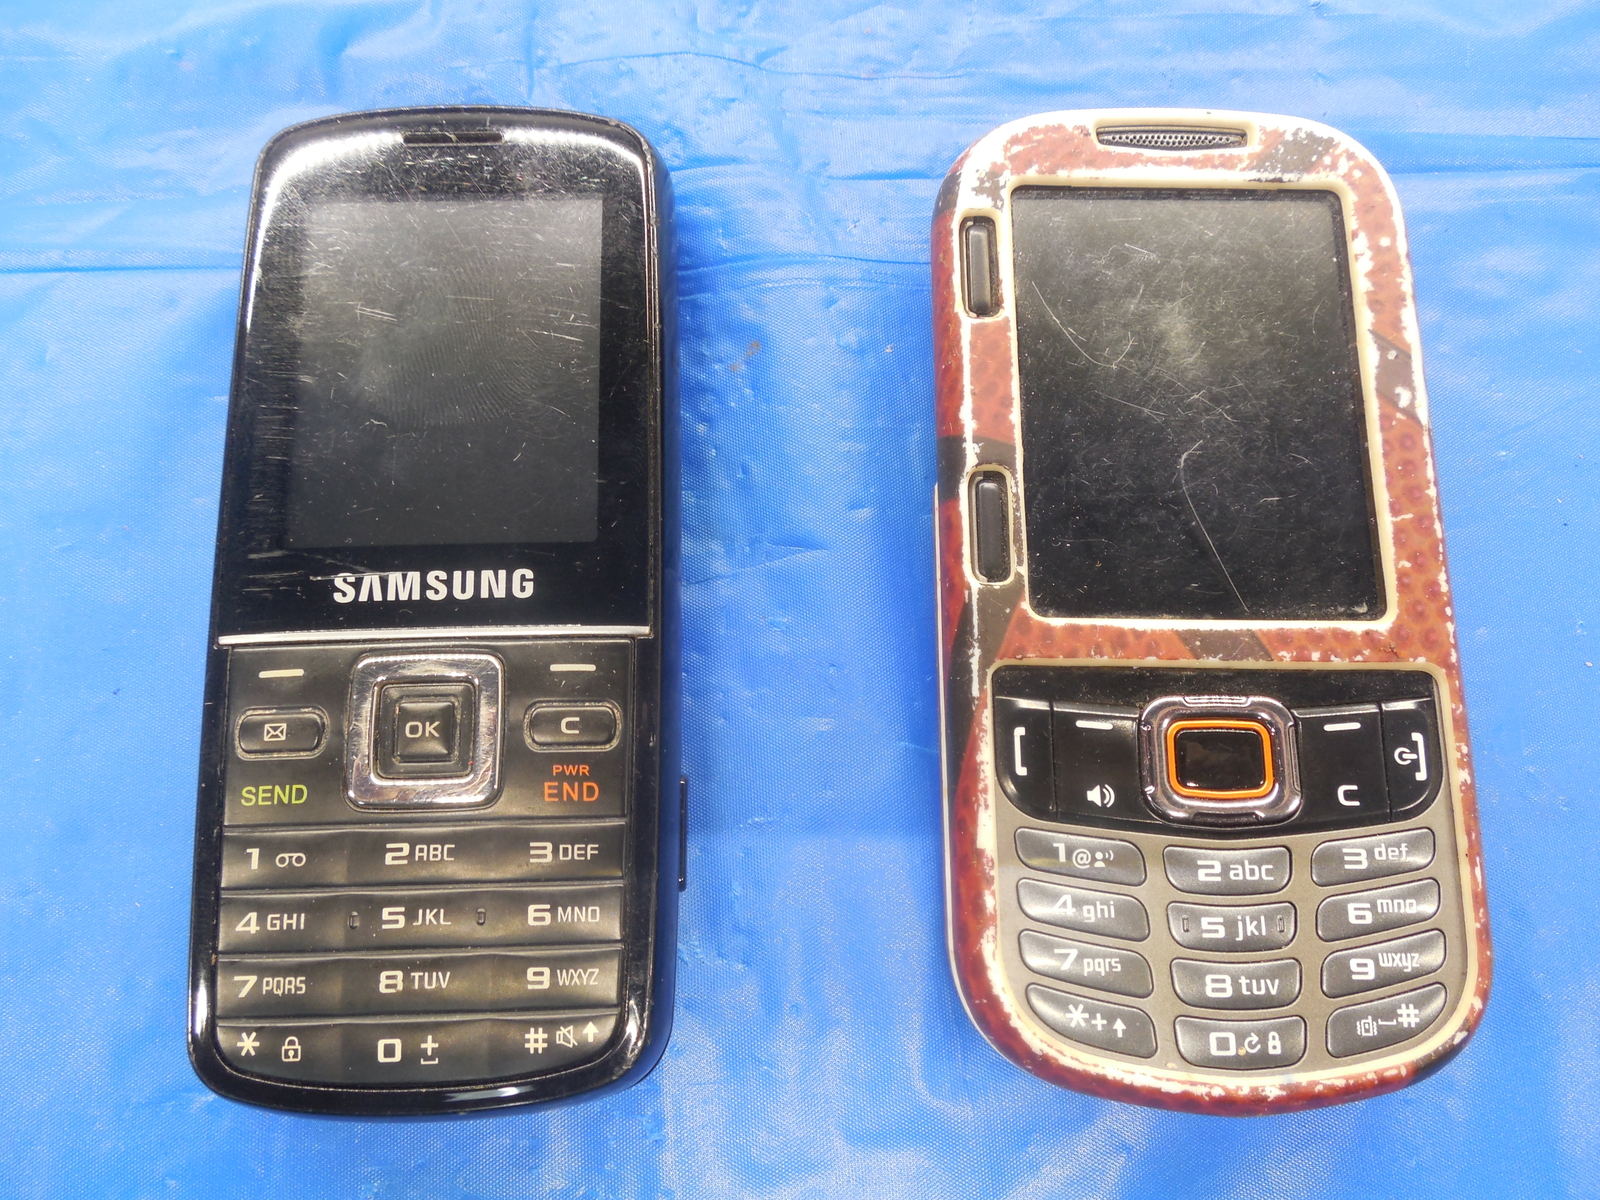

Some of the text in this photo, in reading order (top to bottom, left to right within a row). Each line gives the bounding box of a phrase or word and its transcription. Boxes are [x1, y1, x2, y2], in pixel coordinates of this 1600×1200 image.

[333, 568, 534, 603] SAMSUNG
[405, 721, 440, 738] OK
[560, 717, 580, 734] C
[552, 764, 589, 776] PWR
[241, 784, 308, 807] SEND
[543, 782, 599, 802] END
[246, 848, 260, 870] 1
[385, 842, 455, 865] 2 ABC
[529, 841, 599, 863] 3 DEF
[1343, 843, 1408, 870] 3 def
[1197, 860, 1275, 882] 2 abc
[381, 907, 451, 930] 5 JKL
[527, 904, 600, 926] 6 MNO
[1051, 894, 1115, 922] 4 ghi
[1348, 897, 1417, 925] 6 mno
[235, 912, 306, 934] 4 GHI
[1201, 915, 1267, 941] 5 jkl
[1054, 948, 1122, 976] 7 pqrs
[1349, 950, 1420, 981] 9 wxyz
[233, 975, 306, 998] 7 PQRS
[379, 970, 450, 993] 8 TUV
[526, 967, 599, 990] 9 WXYZ
[1205, 974, 1280, 998] 8 tuv
